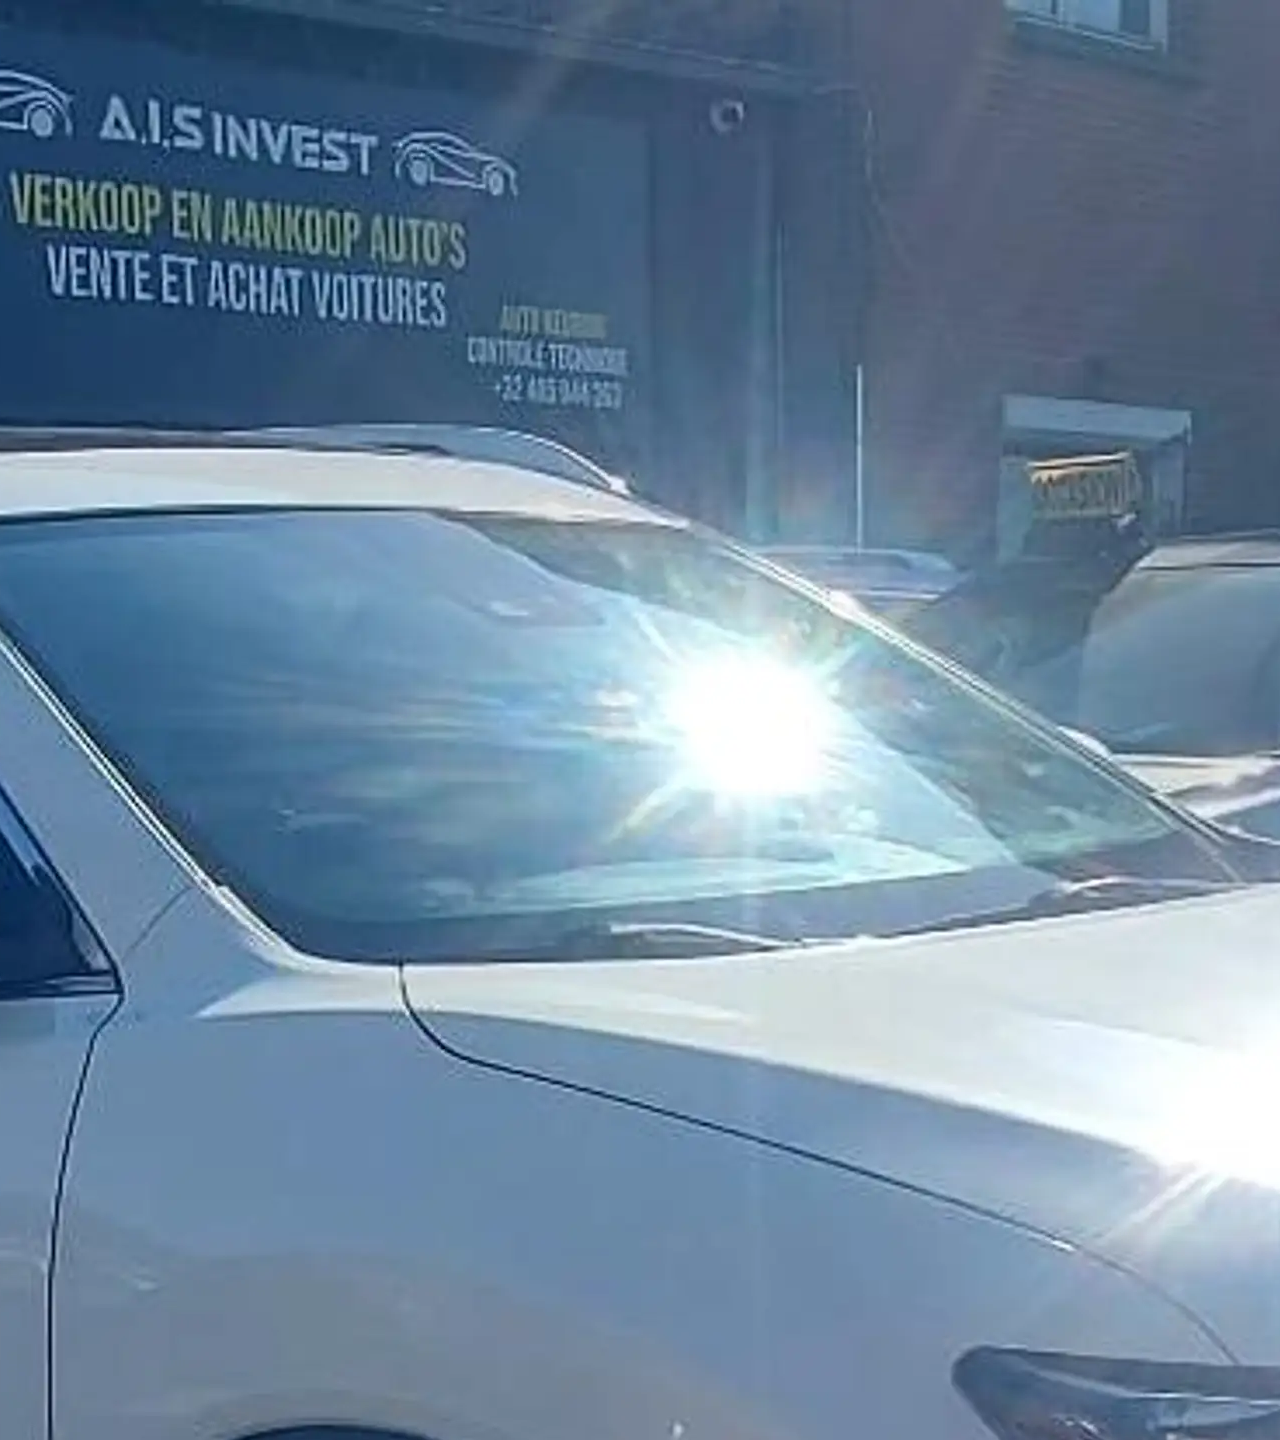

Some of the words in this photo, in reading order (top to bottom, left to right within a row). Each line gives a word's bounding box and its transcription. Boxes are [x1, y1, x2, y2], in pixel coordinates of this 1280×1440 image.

[9, 171, 162, 236] VERKOOP
[172, 188, 212, 243] EN
[221, 197, 360, 260] AANKOOP
[369, 212, 467, 269] AUTO'S
[46, 243, 157, 301] VENTE
[160, 253, 199, 306] ET
[207, 260, 303, 318] ACHAT
[311, 270, 446, 328] VOITURES
